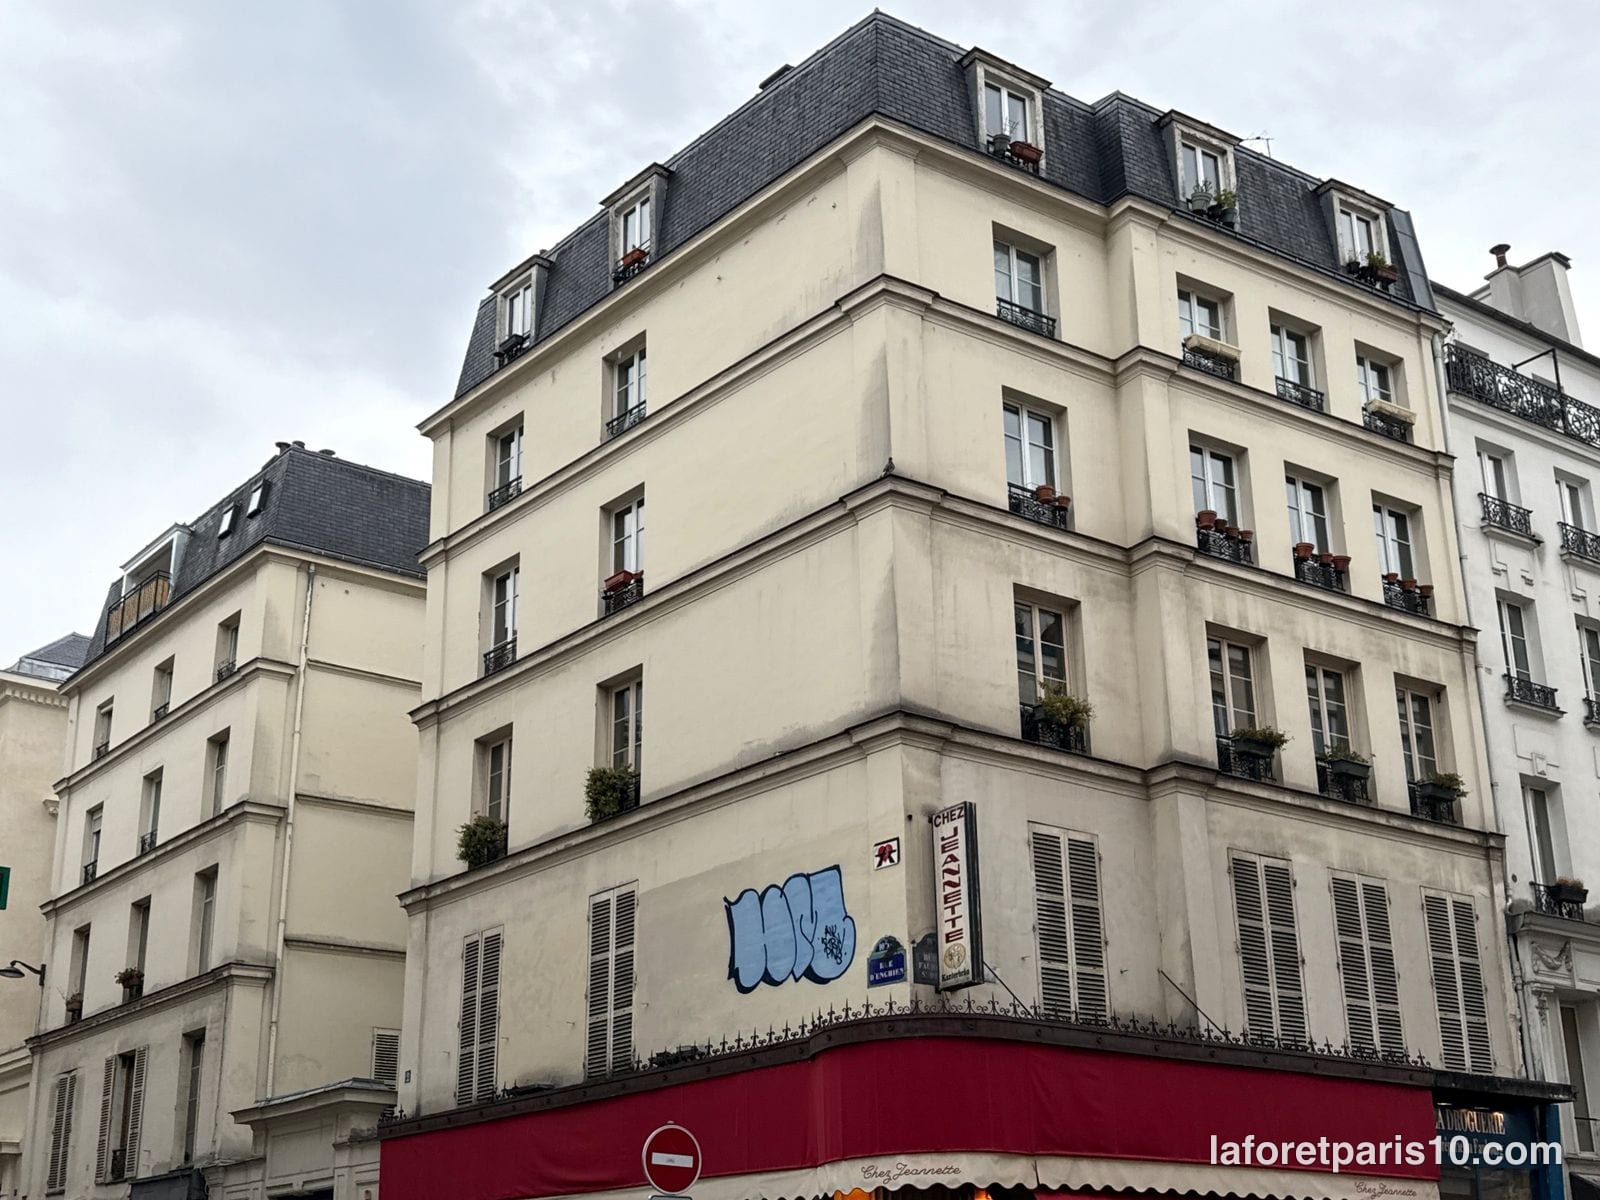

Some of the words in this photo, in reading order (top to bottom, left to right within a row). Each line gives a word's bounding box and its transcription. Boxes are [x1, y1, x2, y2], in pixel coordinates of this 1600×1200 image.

[933, 806, 965, 828] CHEZ
[940, 826, 964, 944] JEANNETTE
[869, 967, 904, 982] D'ENGHIEN
[1435, 1108, 1445, 1130] A
[1445, 1109, 1506, 1135] DROGUERIE
[860, 1164, 892, 1185] Chez
[892, 1162, 962, 1181] Jeannette
[1354, 1181, 1377, 1199] Chez
[1377, 1182, 1418, 1197] Jeannette
